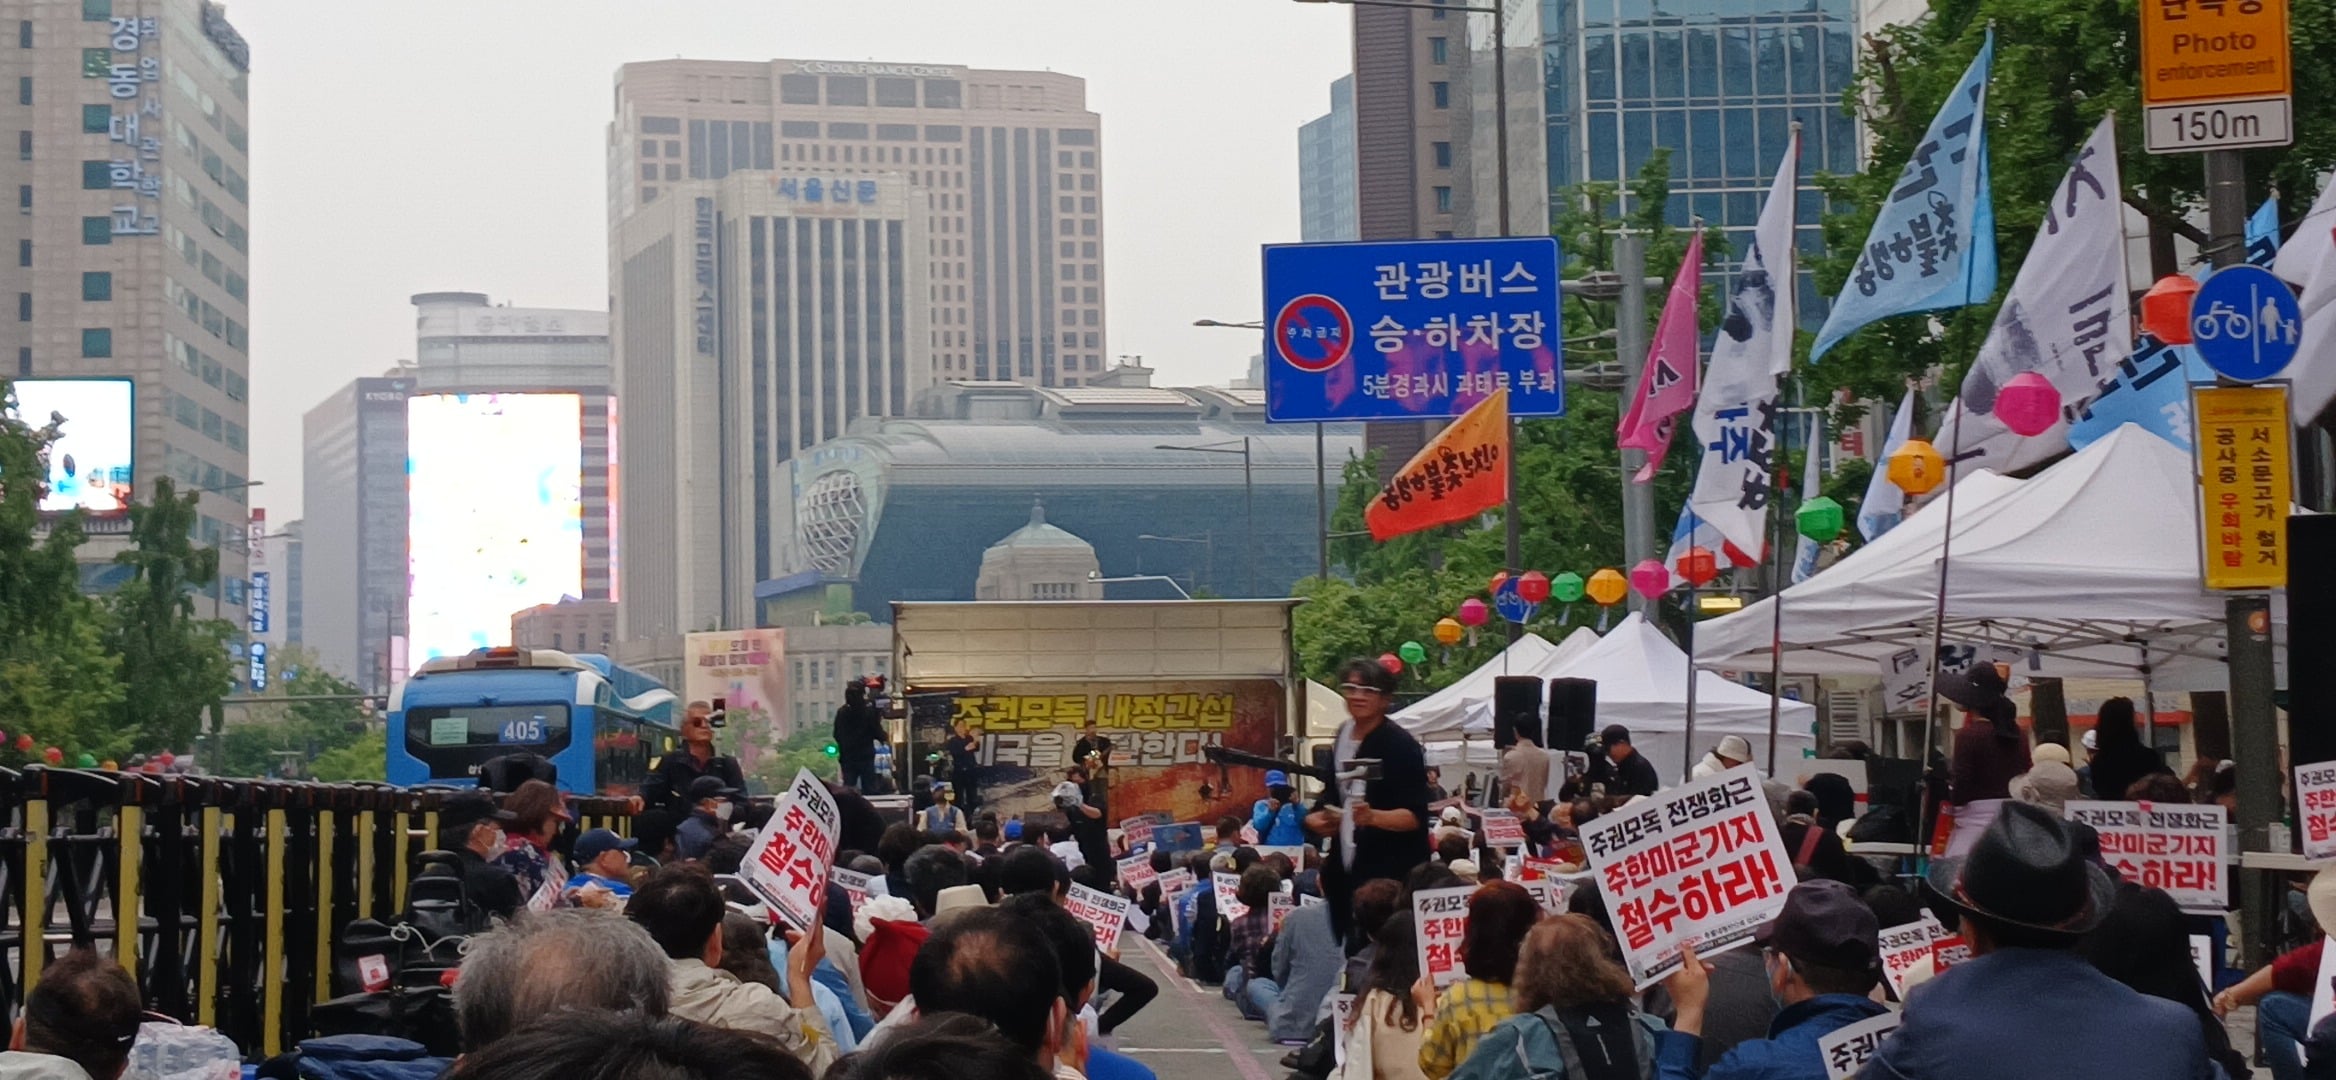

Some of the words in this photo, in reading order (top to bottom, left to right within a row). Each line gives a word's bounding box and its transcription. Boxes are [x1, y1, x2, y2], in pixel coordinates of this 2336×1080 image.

[2173, 31, 2257, 54] Photo
[2157, 56, 2275, 81] enforcement
[108, 17, 142, 236] 경동대학교
[2172, 109, 2260, 141] 150m
[778, 176, 878, 204] 서울신문
[1373, 259, 1539, 301] 관광버스
[1369, 310, 1546, 353] 승·하차장
[1362, 371, 1449, 398] 5분경과시
[1518, 369, 1556, 395] 부과
[2214, 428, 2238, 485] 공사중
[2251, 427, 2276, 521] 서소문고가
[504, 720, 540, 740] 405
[950, 695, 1089, 730] 주권모독
[1096, 693, 1233, 730] 내정간섭
[1589, 808, 1663, 858] 주권모독
[1666, 776, 1756, 828] 전쟁화근
[1603, 811, 1765, 897] 주한미군기지
[1617, 849, 1784, 951] 철수하라!
